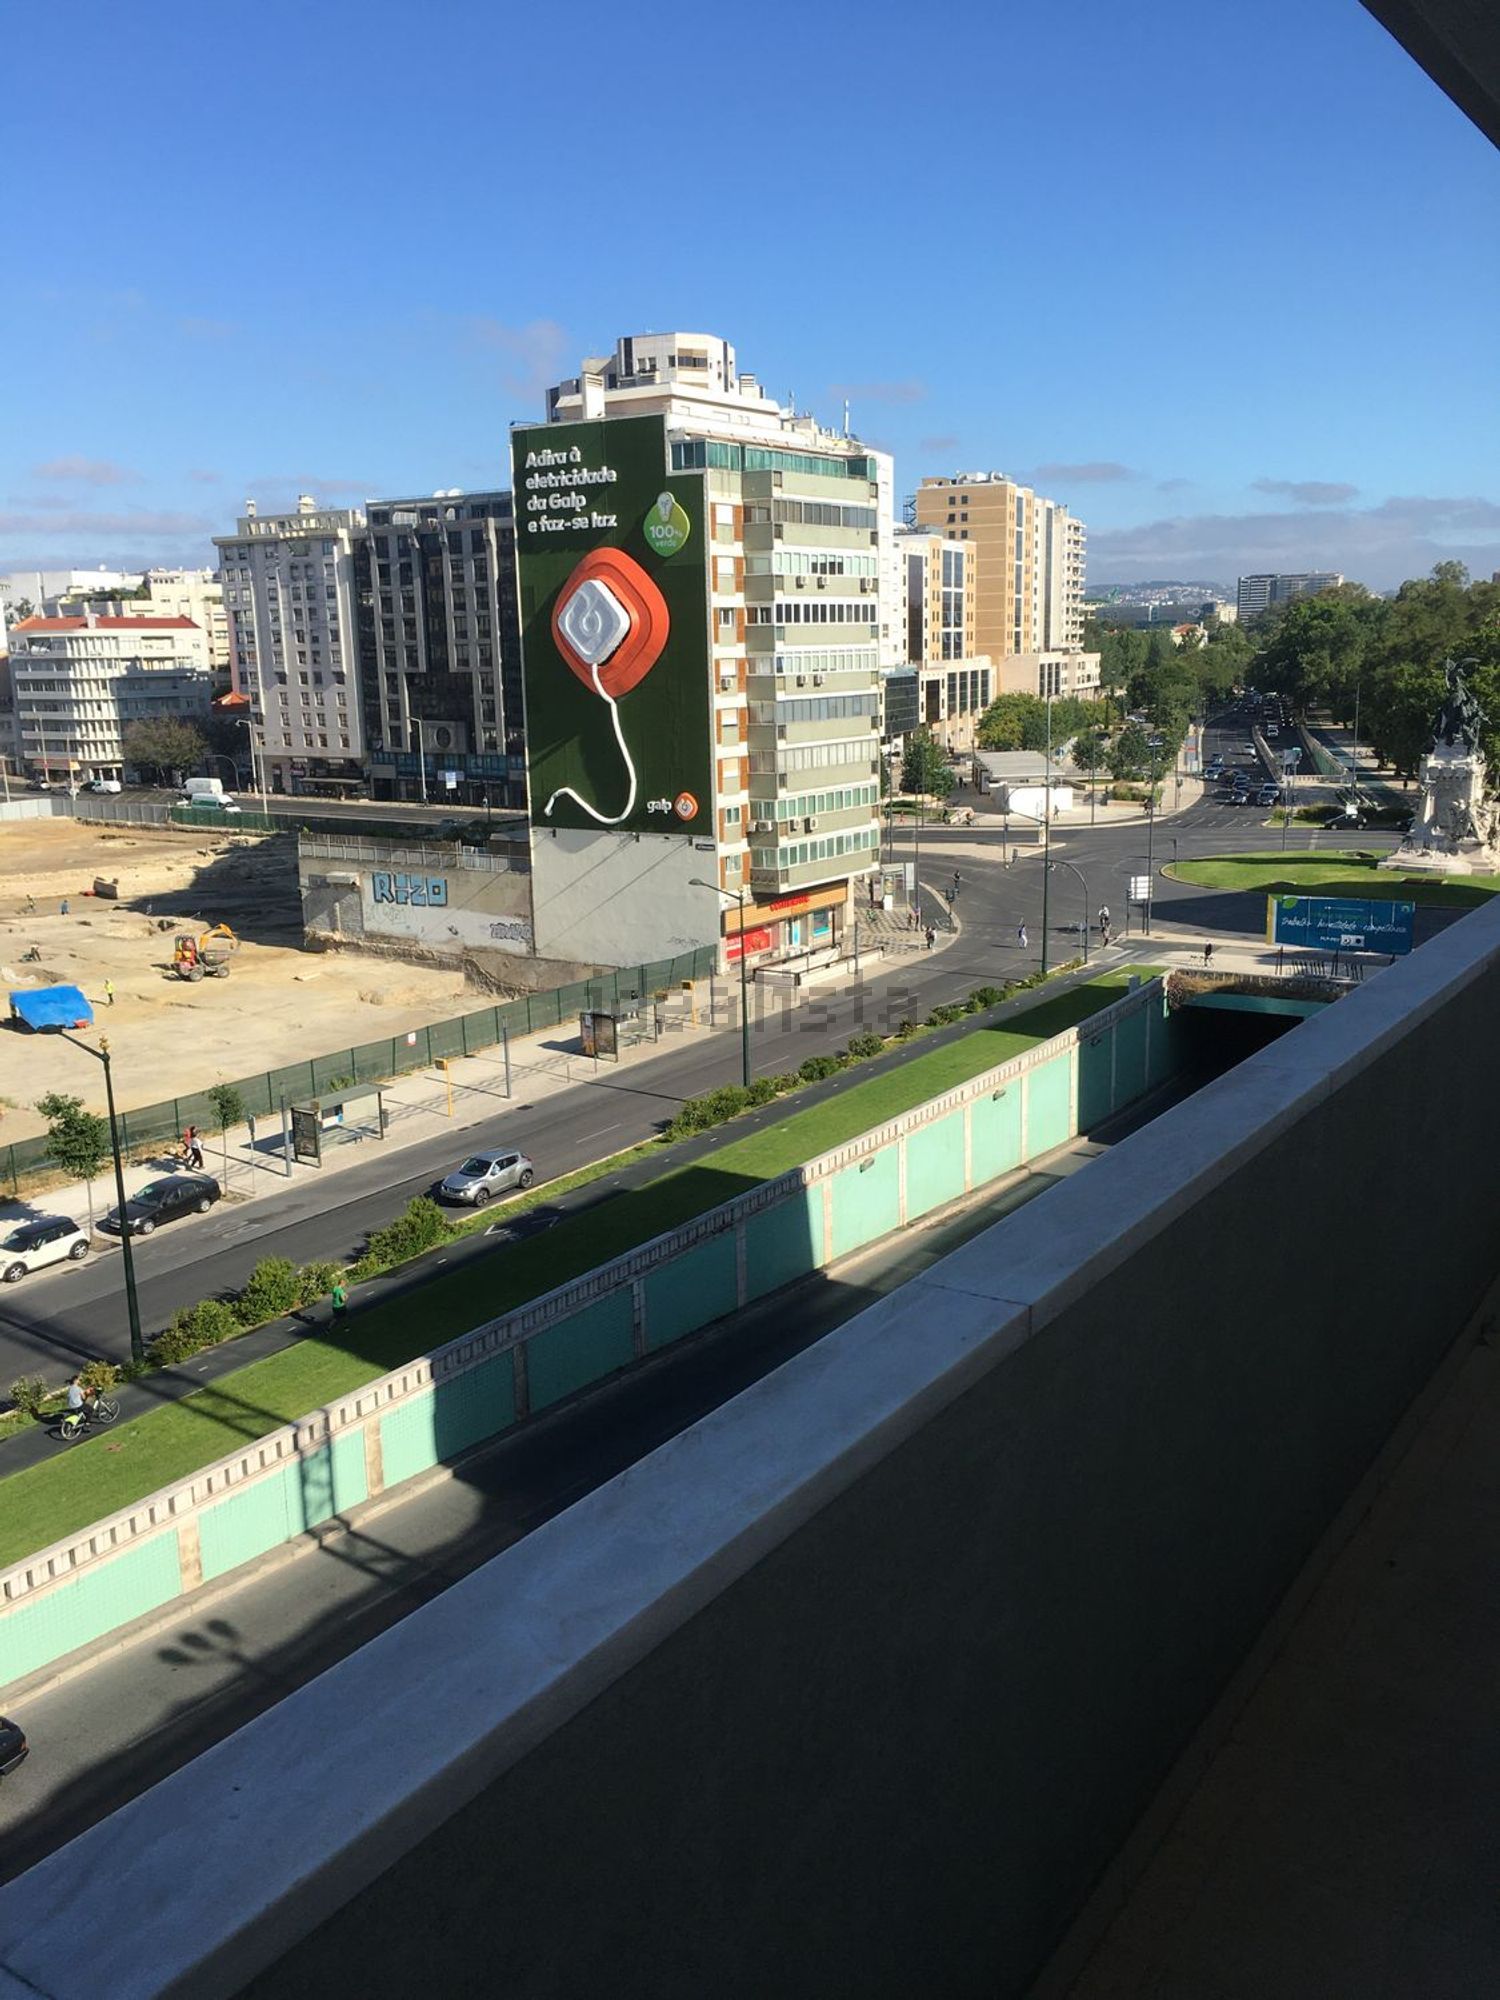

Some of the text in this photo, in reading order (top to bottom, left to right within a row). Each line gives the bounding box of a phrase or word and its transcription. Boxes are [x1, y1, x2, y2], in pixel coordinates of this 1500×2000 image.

[525, 446, 582, 468] Adira à
[525, 466, 617, 490] eletricidade
[526, 491, 587, 512] da Galp
[527, 519, 538, 533] e
[539, 515, 589, 532] faz-se
[646, 798, 672, 815] galp
